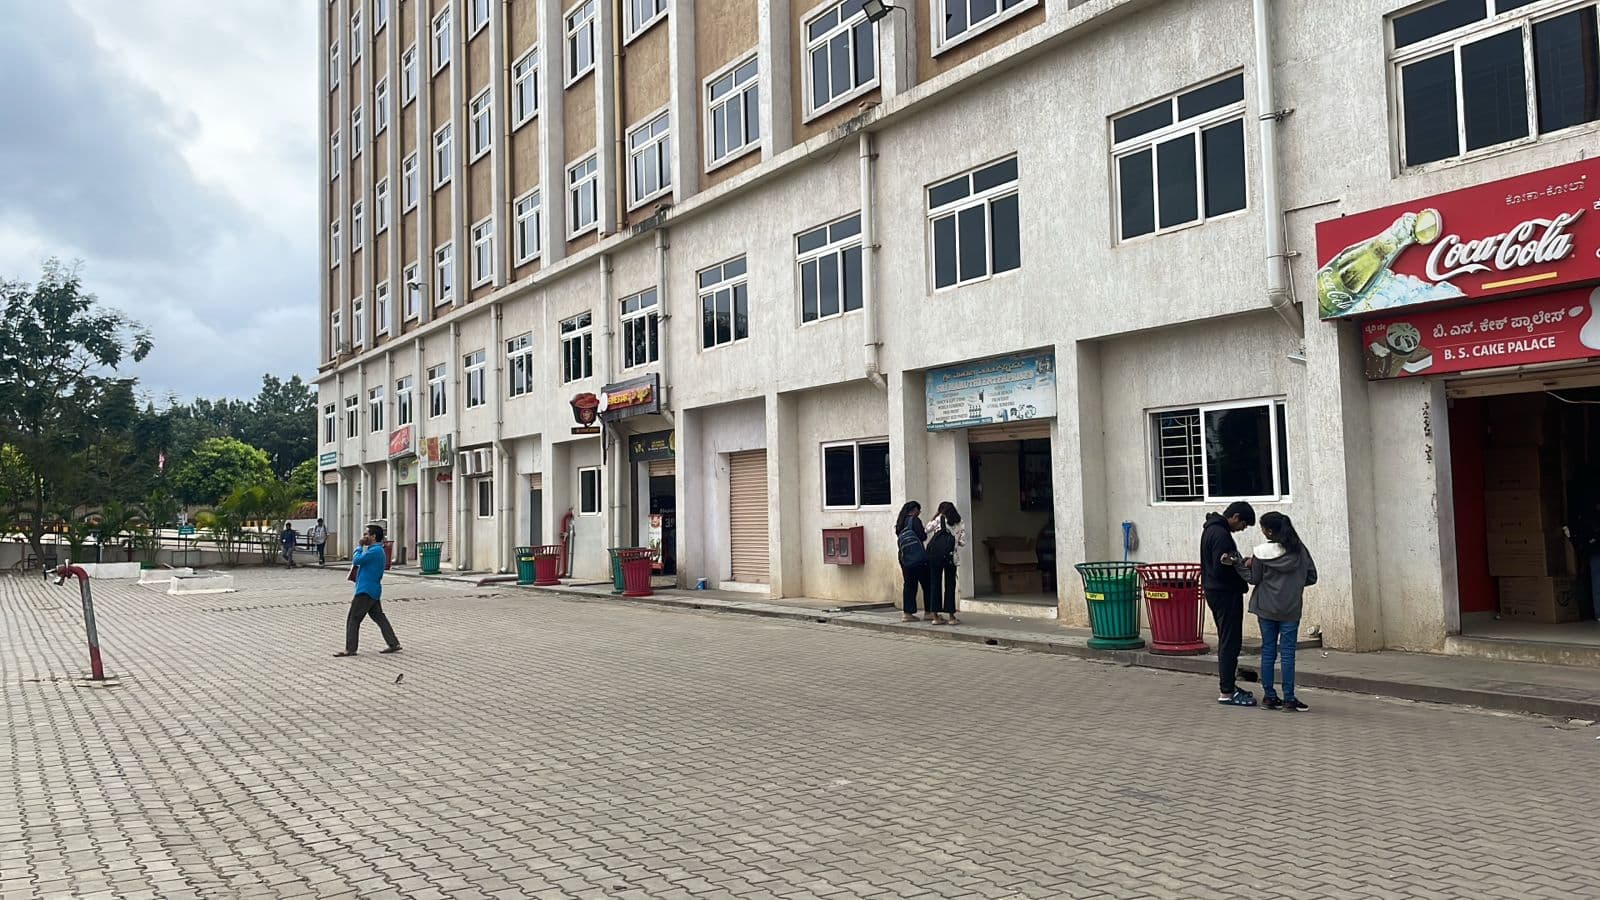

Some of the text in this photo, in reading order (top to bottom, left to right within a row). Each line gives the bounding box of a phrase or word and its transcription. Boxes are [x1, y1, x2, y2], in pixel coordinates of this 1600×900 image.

[1426, 208, 1585, 281] Coca-Cola
[1479, 316, 1508, 332] ಕೇಕ್
[1511, 308, 1566, 333] ಪ್ಯಾಲೇಸ್
[1444, 336, 1556, 360] B. S. CAKE PALACE
